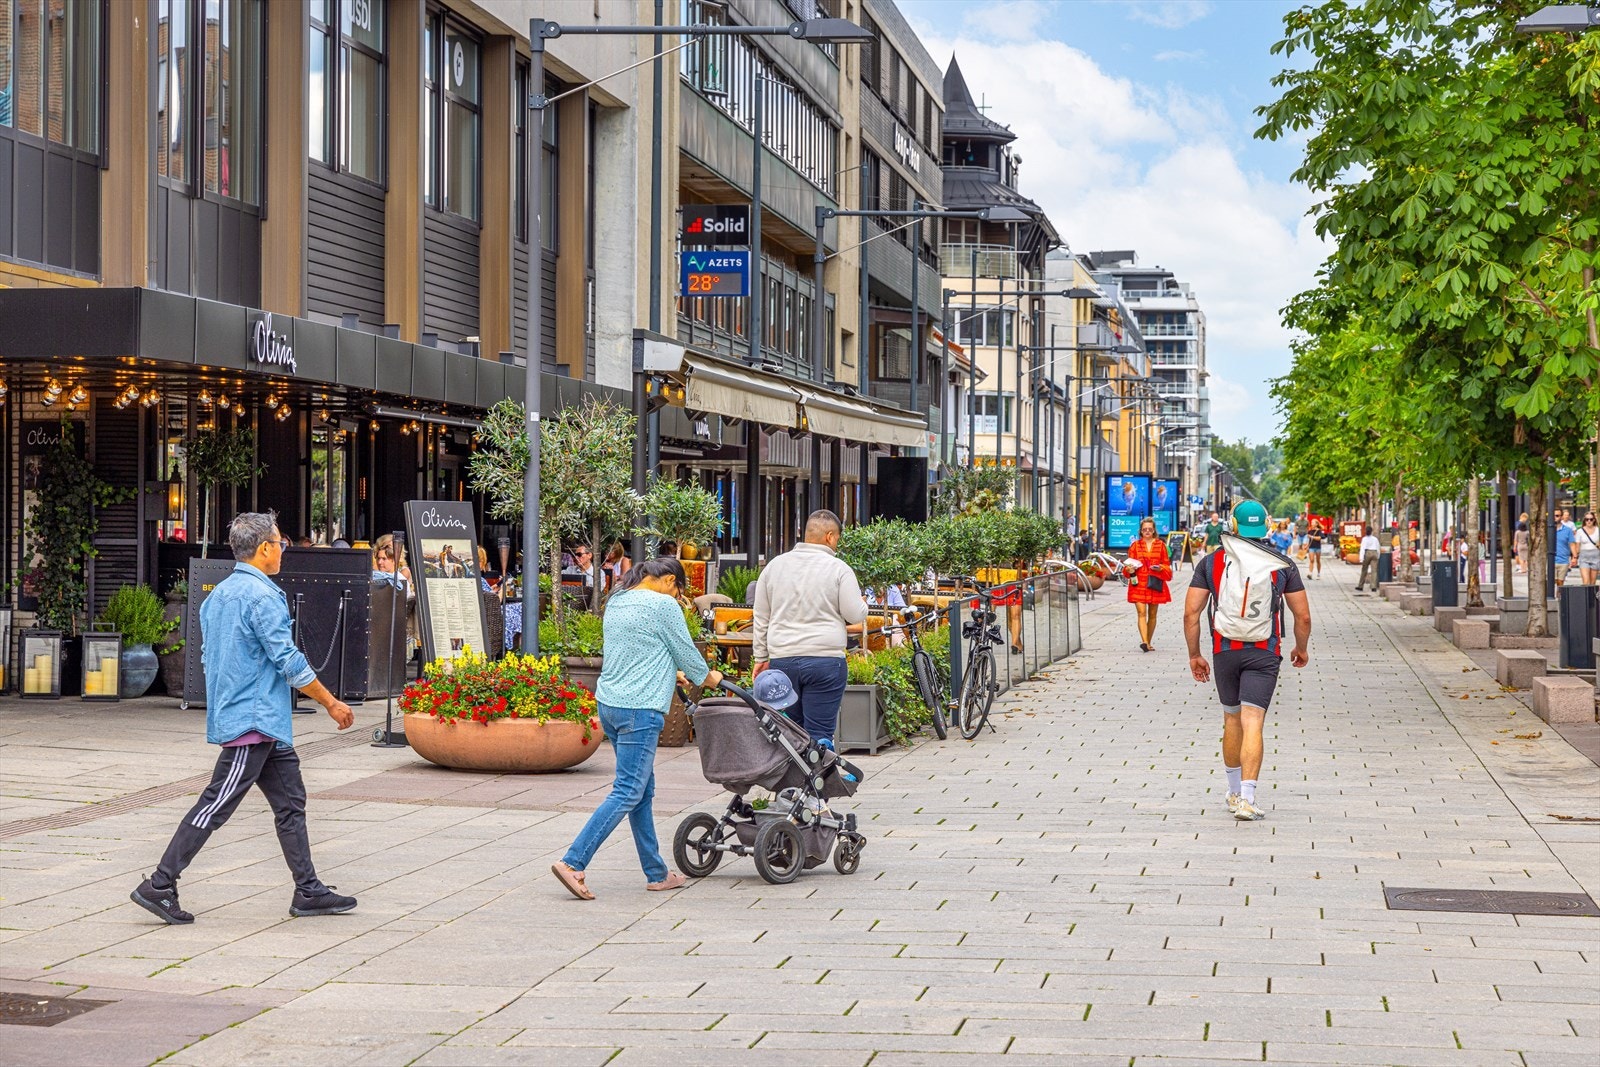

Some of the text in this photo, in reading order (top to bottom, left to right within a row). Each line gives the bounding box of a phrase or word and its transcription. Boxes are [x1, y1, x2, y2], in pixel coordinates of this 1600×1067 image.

[704, 217, 744, 232] Solid
[708, 258, 742, 267] AZETS
[689, 274, 720, 291] 28°
[256, 311, 297, 373] Olivia
[27, 426, 60, 446] Olivi
[421, 507, 467, 530] Olivia
[1111, 518, 1126, 526] 20x
[1246, 600, 1262, 619] S
